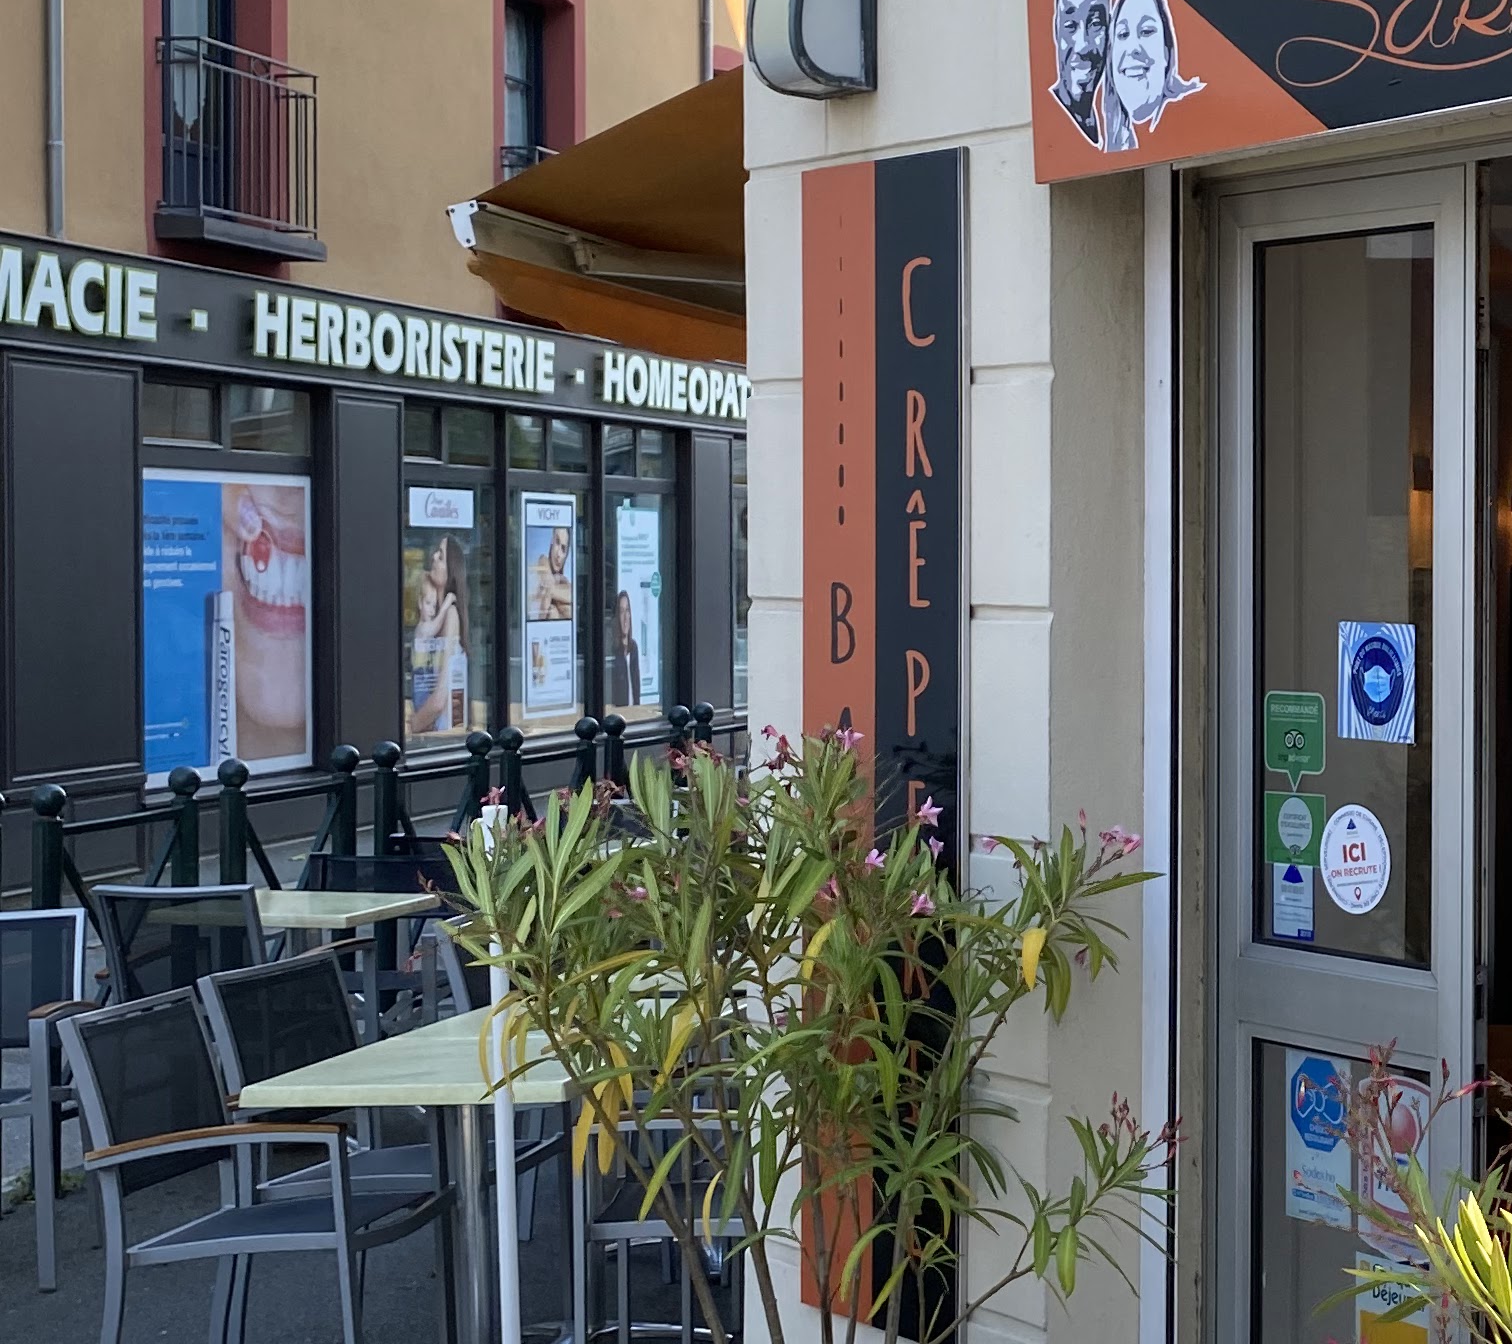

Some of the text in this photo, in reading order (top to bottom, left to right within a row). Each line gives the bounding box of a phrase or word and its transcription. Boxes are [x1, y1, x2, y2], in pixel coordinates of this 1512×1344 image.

[254, 290, 556, 394] HERBORISTERIE
[537, 508, 560, 521] VICHY
[1343, 842, 1366, 863] ICI
[1331, 869, 1342, 878] ON
[1344, 864, 1378, 877] RECRUTE
